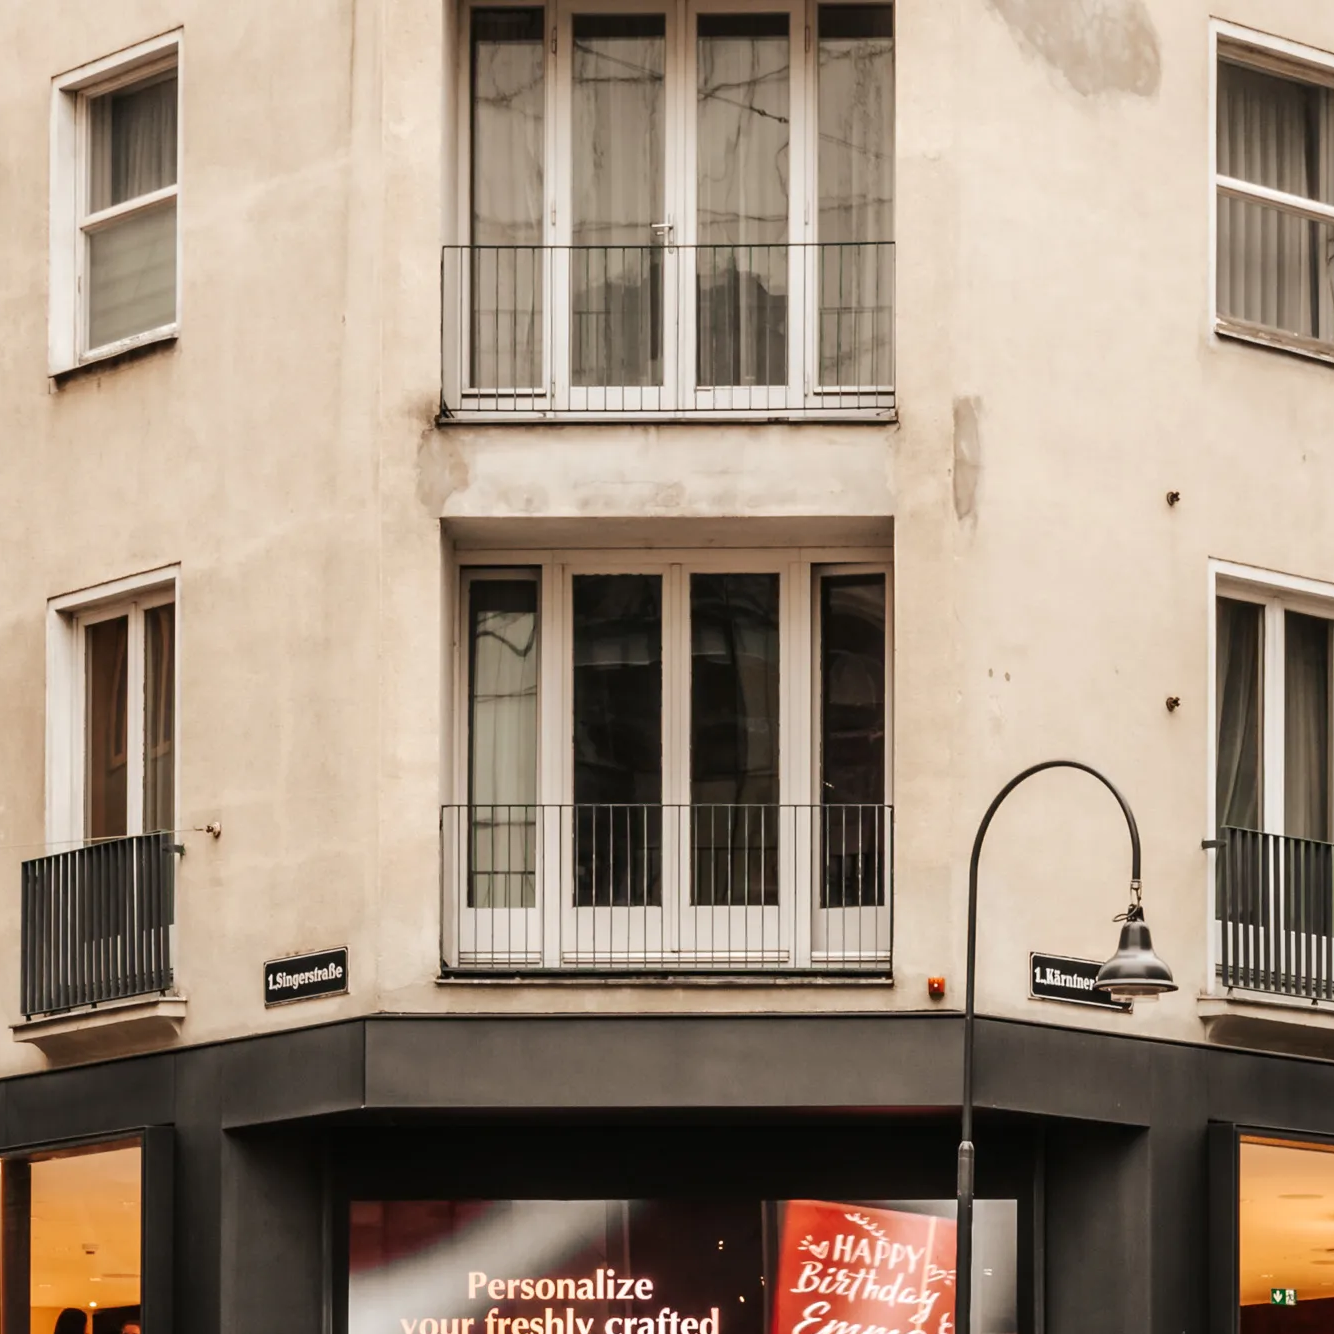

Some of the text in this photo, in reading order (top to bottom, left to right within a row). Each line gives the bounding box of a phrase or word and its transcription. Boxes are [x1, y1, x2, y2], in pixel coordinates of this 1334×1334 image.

[832, 1234, 925, 1274] HAPPY
[465, 1269, 654, 1301] Personalize
[789, 1260, 941, 1324] Birthday
